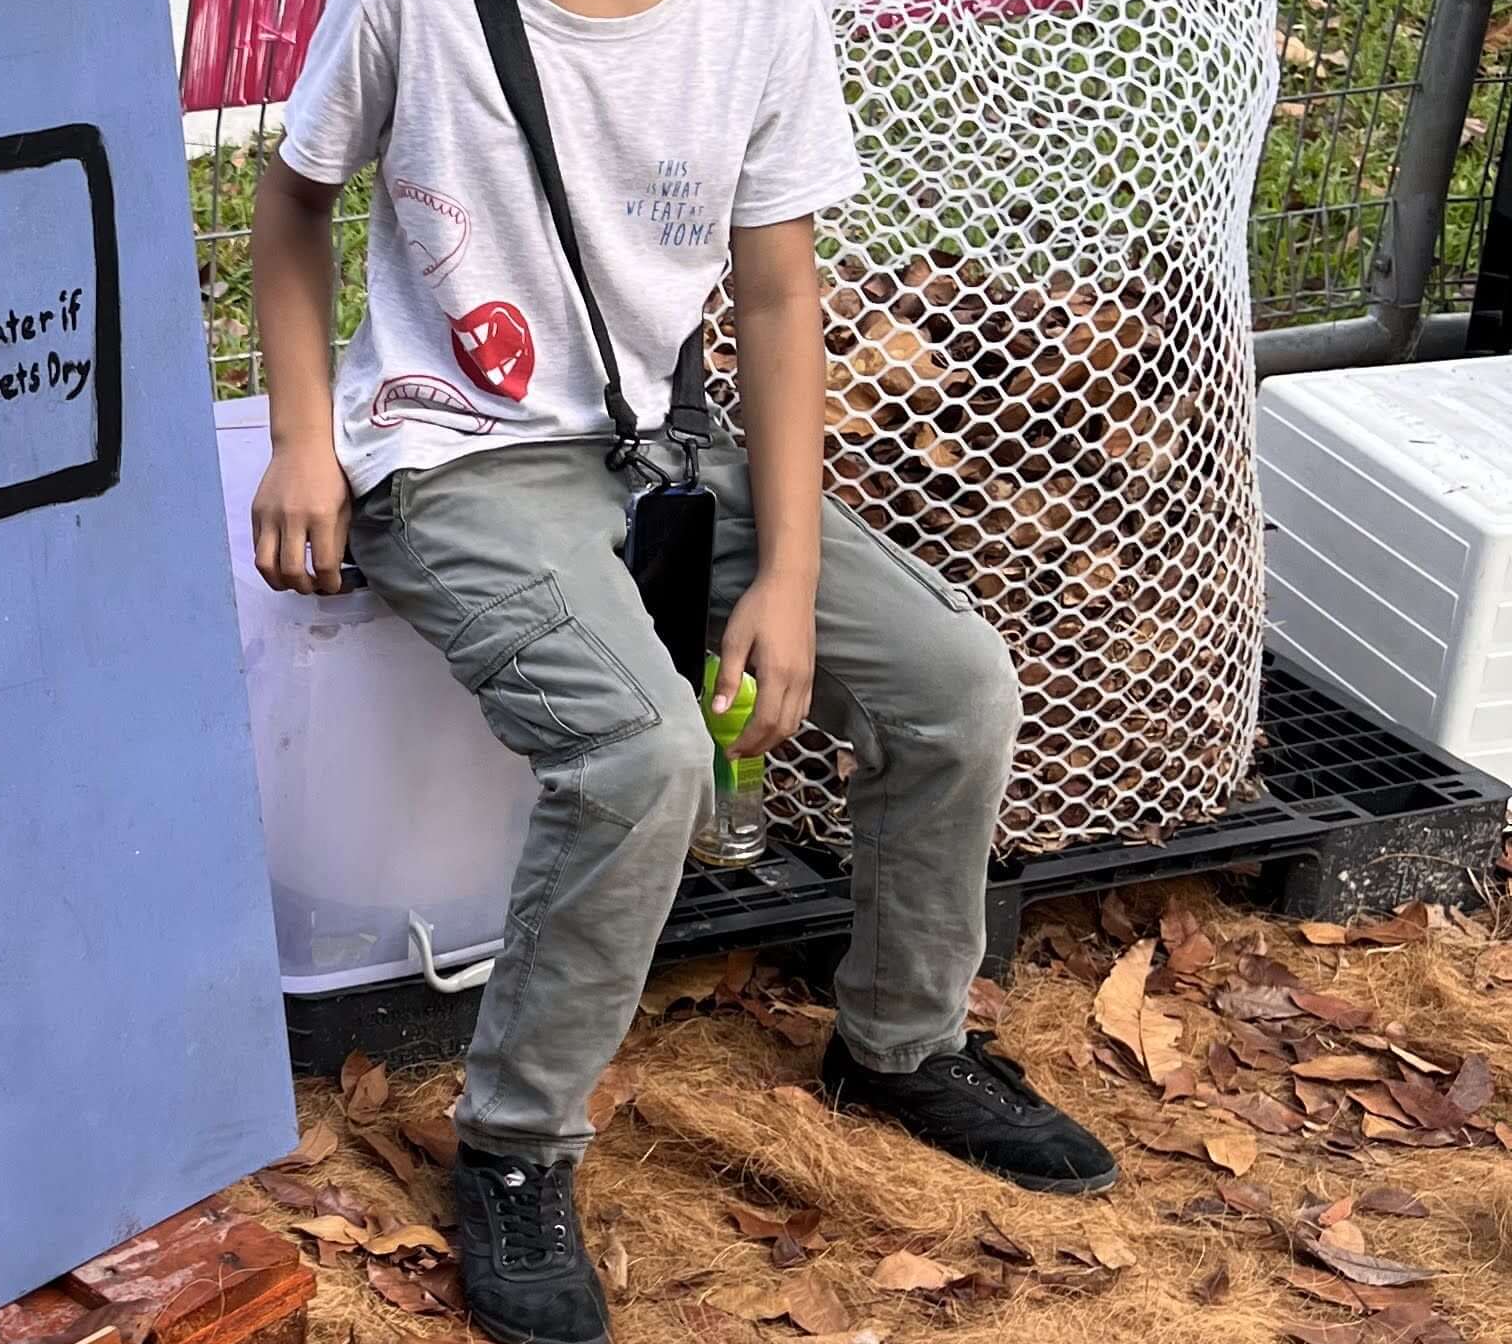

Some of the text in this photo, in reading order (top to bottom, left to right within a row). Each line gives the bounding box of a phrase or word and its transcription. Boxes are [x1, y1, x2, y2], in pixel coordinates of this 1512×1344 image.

[657, 160, 688, 177] THIS
[661, 181, 702, 197] WHAT
[626, 199, 645, 216] WE
[651, 200, 687, 221] EAT
[659, 222, 716, 246] HOME
[59, 288, 83, 332] if
[47, 351, 91, 401] Dry
